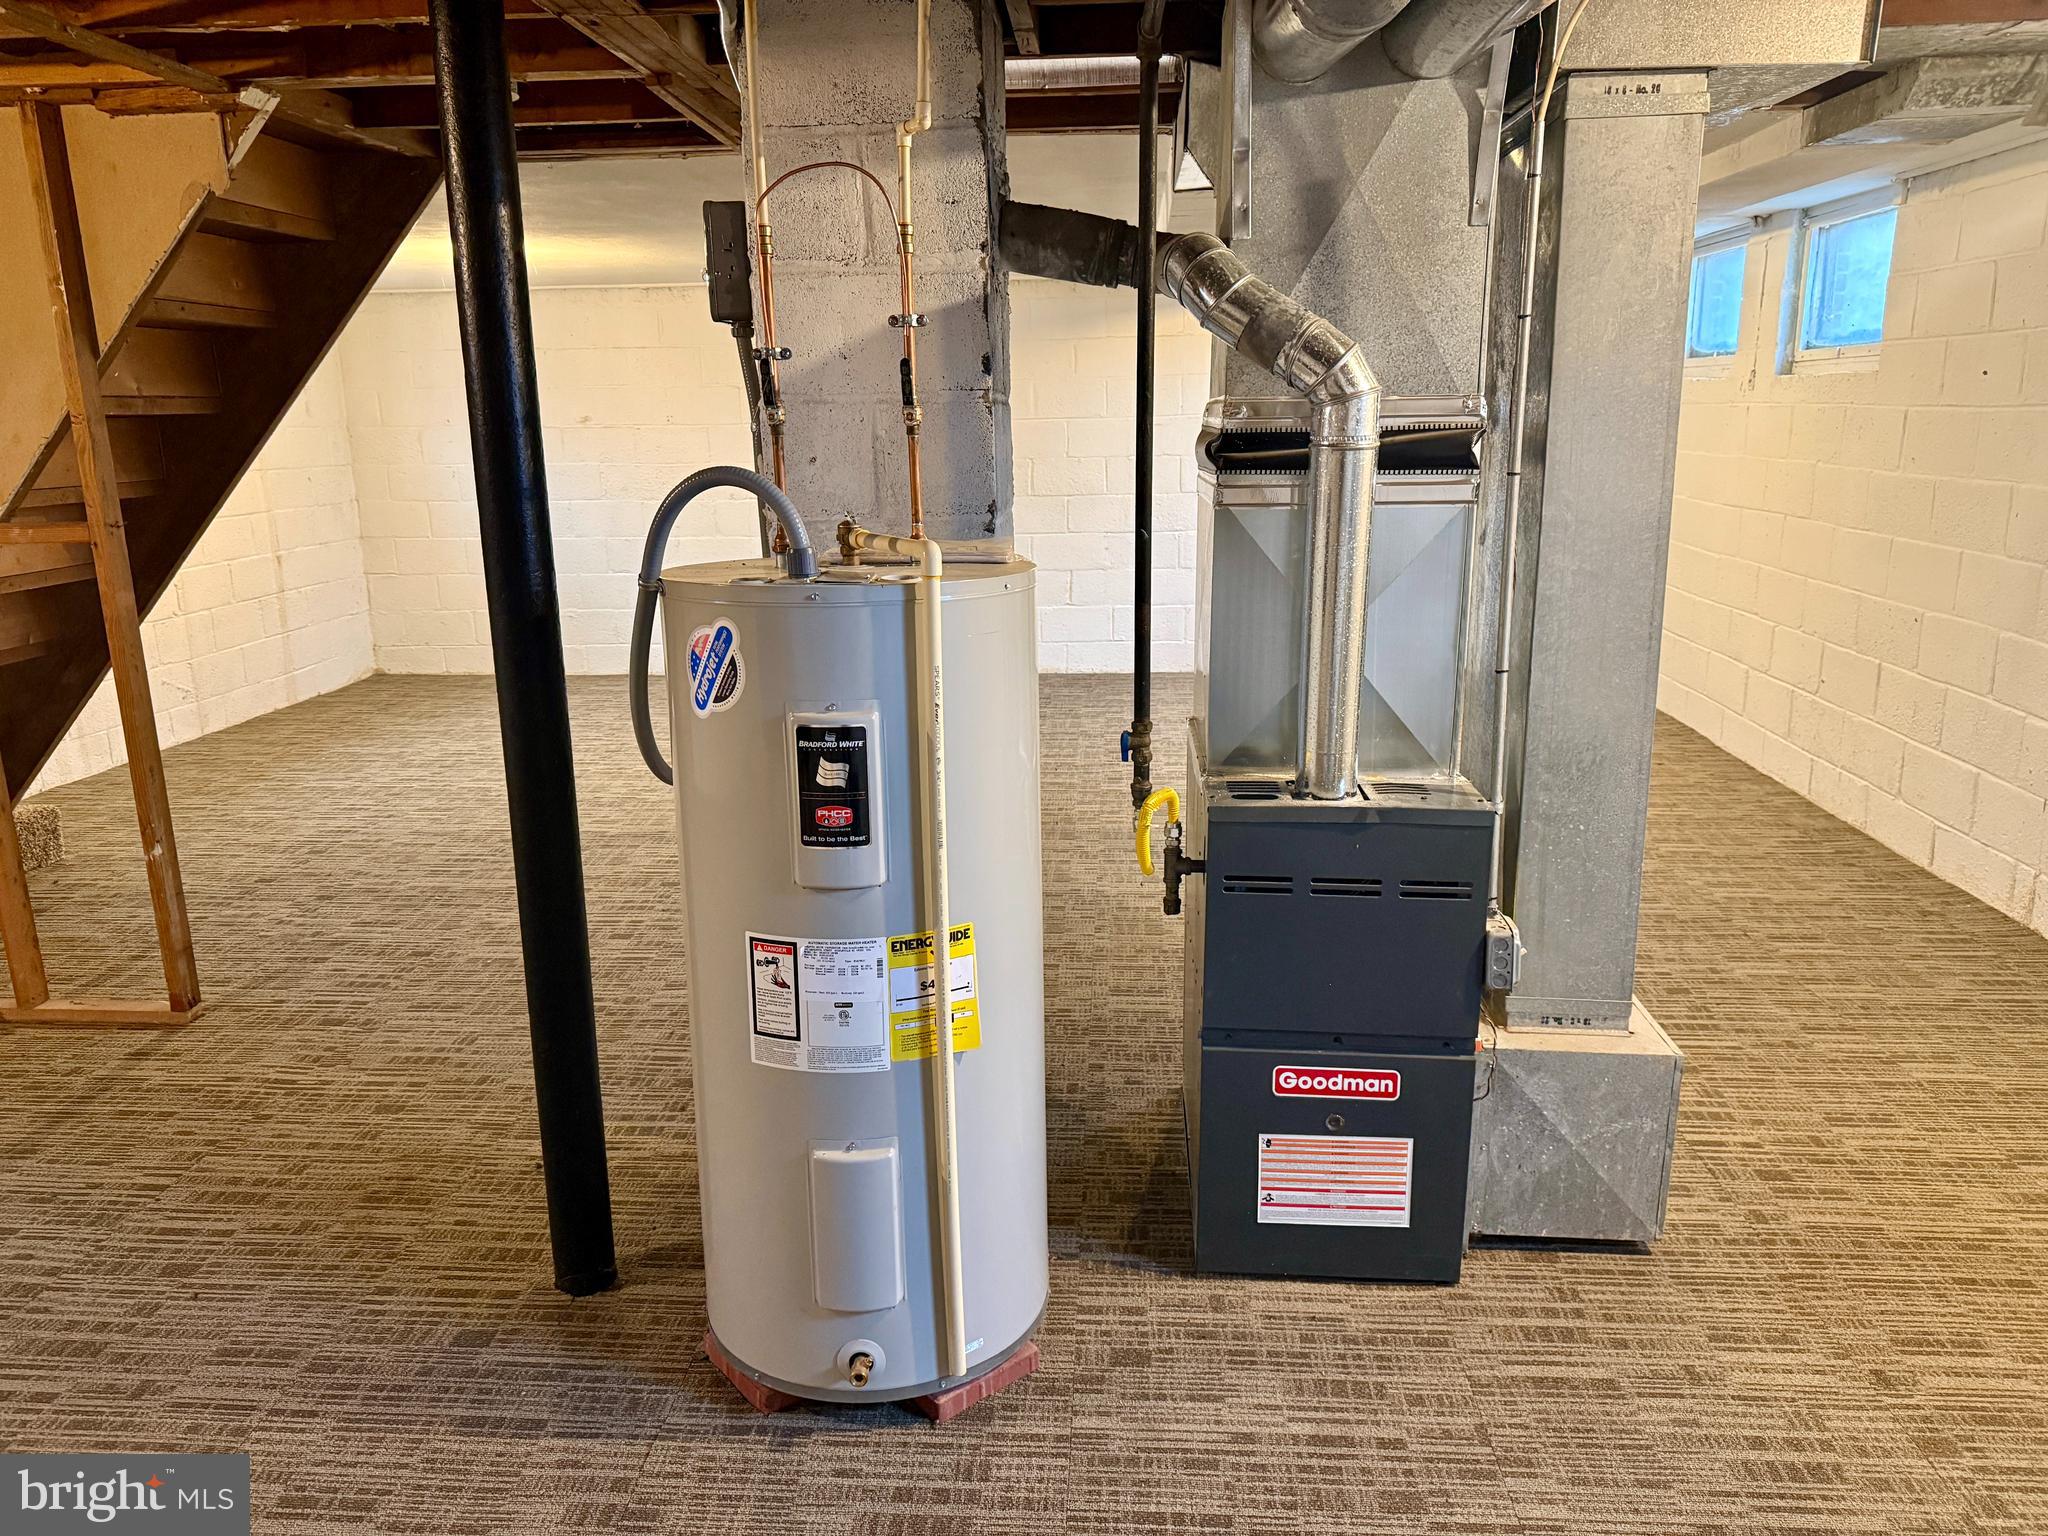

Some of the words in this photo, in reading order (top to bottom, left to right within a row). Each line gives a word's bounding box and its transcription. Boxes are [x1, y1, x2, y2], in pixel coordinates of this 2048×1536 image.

[696, 650, 718, 705] Hydrojet
[798, 740, 838, 748] BRADFORD
[839, 740, 864, 748] WHITE
[763, 945, 787, 954] DANGER
[1279, 1071, 1394, 1093] Goodman
